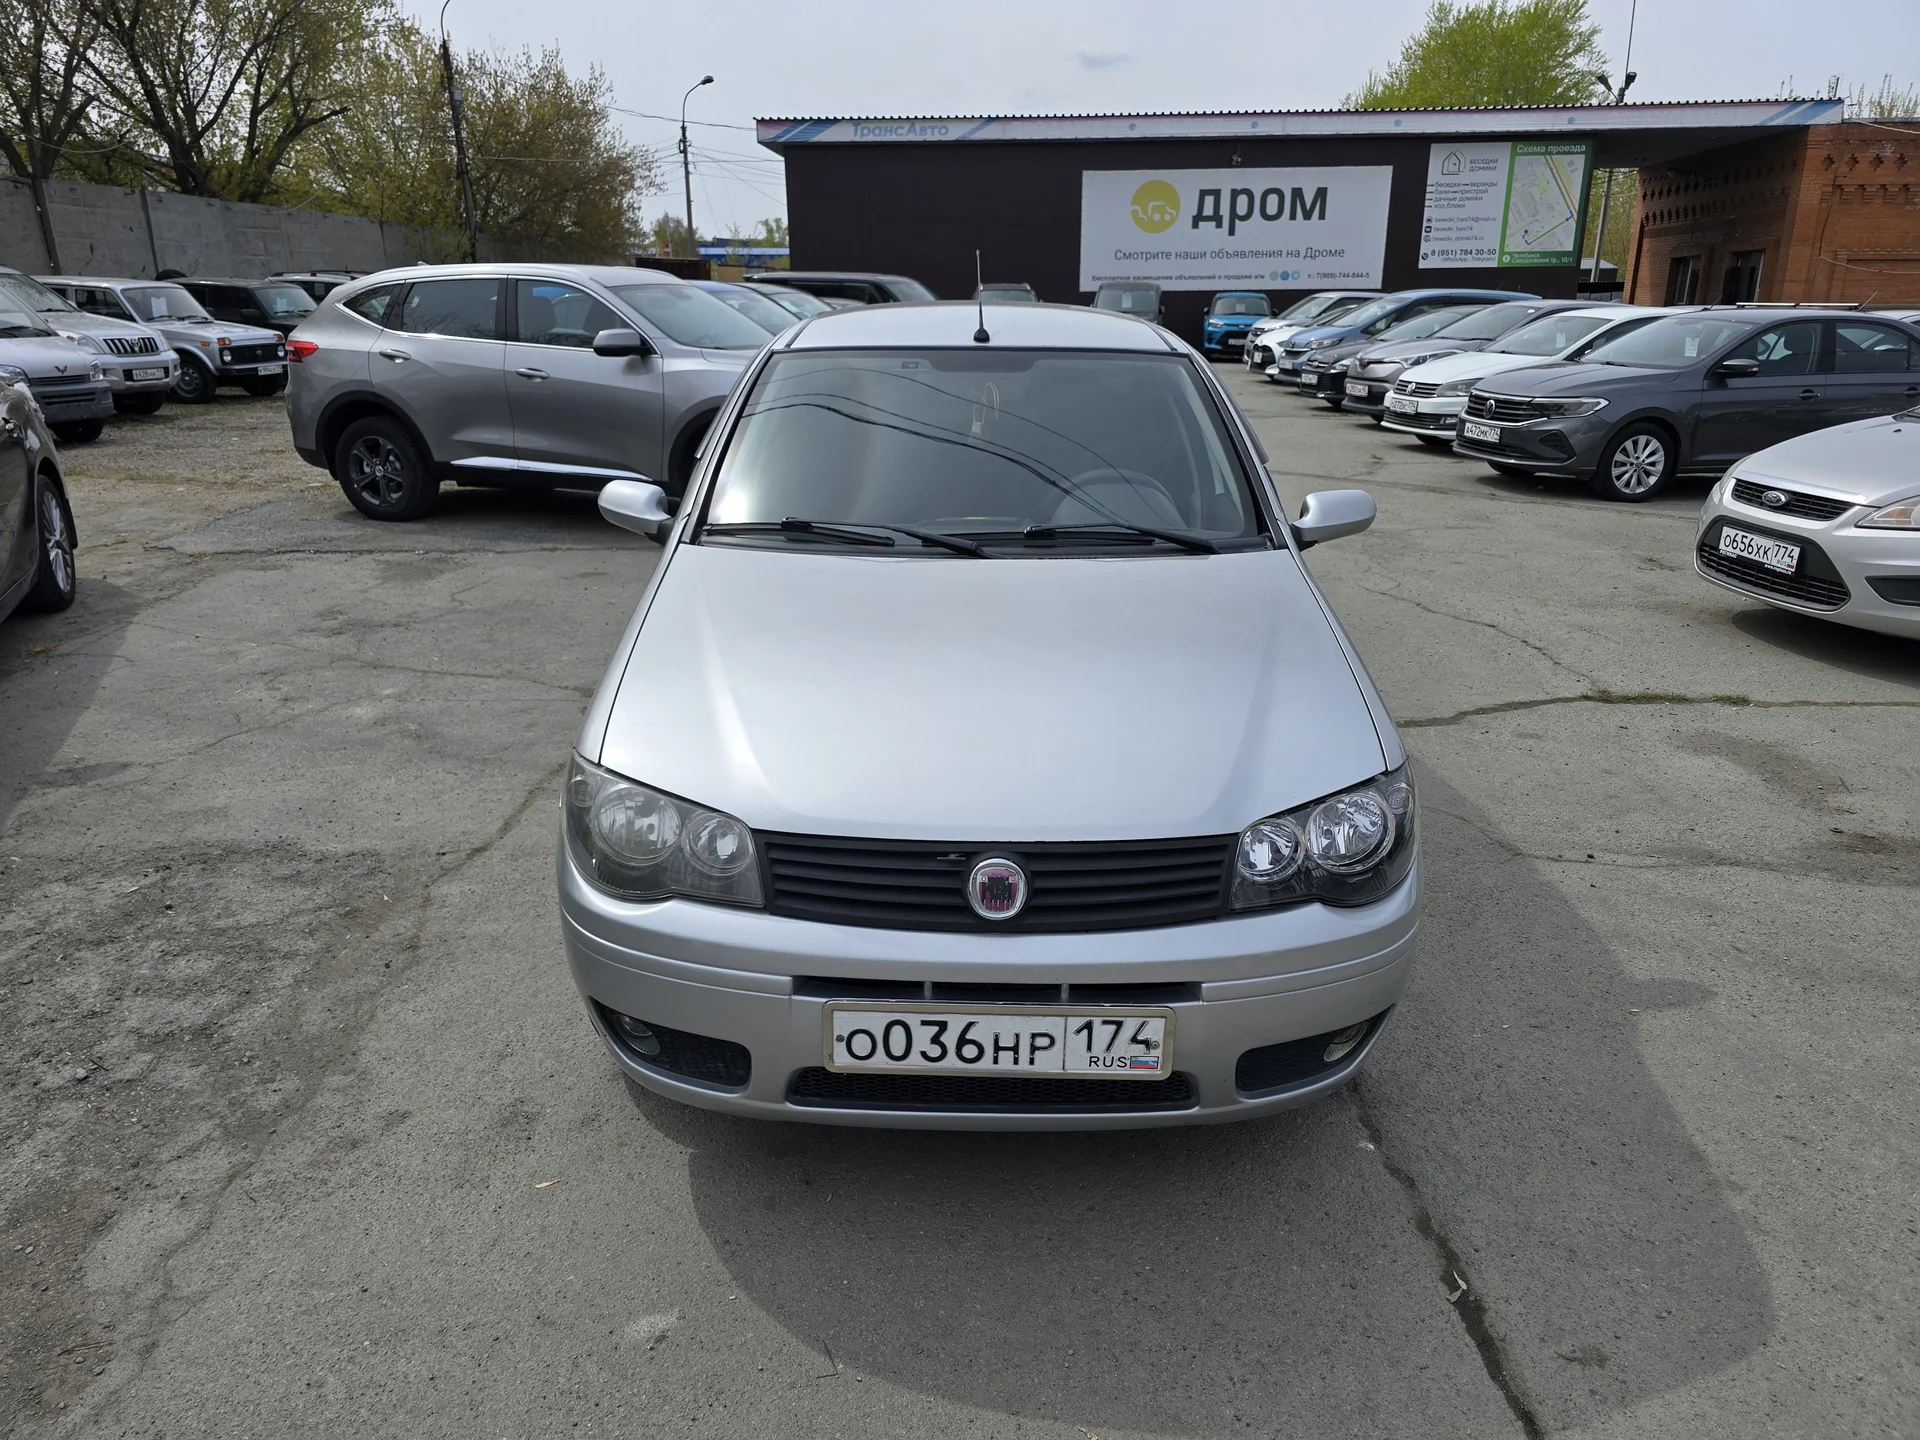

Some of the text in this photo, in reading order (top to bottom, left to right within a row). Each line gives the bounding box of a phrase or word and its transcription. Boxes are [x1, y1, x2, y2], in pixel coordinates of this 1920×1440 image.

[852, 121, 949, 138] ТрансАвто
[1517, 144, 1586, 154] Схема проезда
[1191, 186, 1328, 236] дром
[1114, 247, 1345, 262] Смотрите наши объявления на Дроме
[1430, 249, 1436, 257] 8
[1437, 249, 1457, 257] (951)
[1474, 248, 1497, 256] 30-50
[1774, 543, 1796, 563] 774
[1072, 1018, 1152, 1055] 174
[1088, 1055, 1128, 1069] RUS
